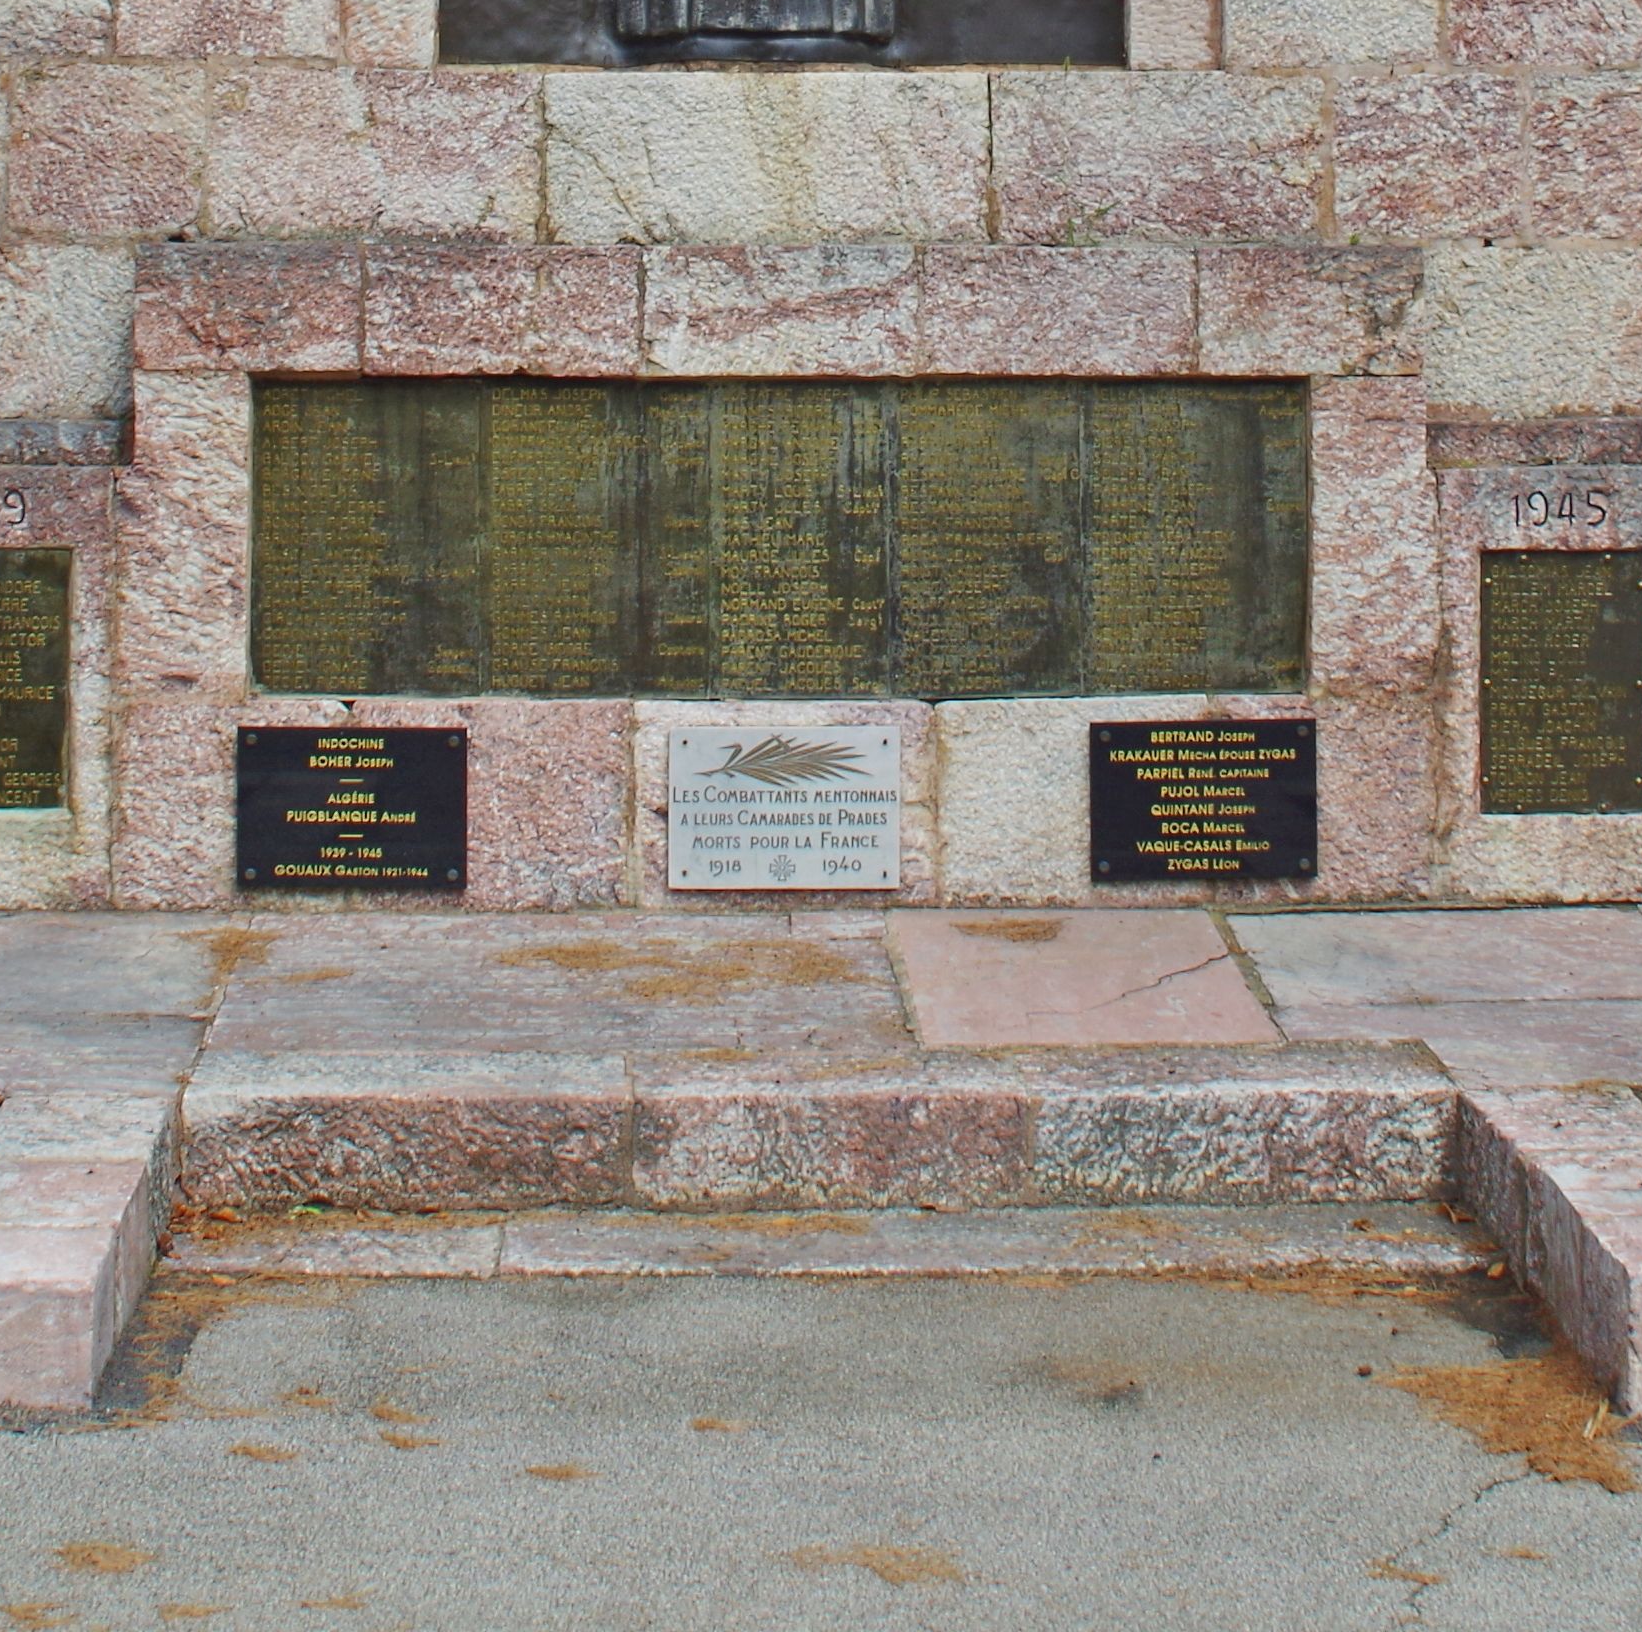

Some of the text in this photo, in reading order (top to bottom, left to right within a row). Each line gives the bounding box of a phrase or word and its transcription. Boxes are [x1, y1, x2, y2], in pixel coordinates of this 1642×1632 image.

[492, 389, 607, 401] DELMAS JOSEPH
[1511, 491, 1607, 527] 1945
[721, 550, 779, 563] MAURICE
[755, 566, 820, 578] FRANCOIS
[773, 583, 829, 594] JOSEPH
[1558, 582, 1612, 596] MARCEL
[721, 598, 845, 613] NORMAND EUGENE
[1545, 634, 1589, 647] ROGER
[553, 675, 591, 688] JEAN
[1491, 703, 1597, 716] PRATX GASTON
[1151, 731, 1255, 742] BERTRAND JOSEPH
[318, 739, 384, 749] INDOCHINE
[1110, 750, 1174, 761] KRAKAUER
[1259, 749, 1296, 759] ZYGAS
[309, 756, 351, 767] BOHER
[1137, 768, 1184, 779] PARPIEL
[1551, 771, 1587, 785] JEAN
[4, 773, 62, 787] GEORGES
[327, 791, 375, 803] ALGÉRIE
[814, 789, 897, 803] MENTONNAIS
[1161, 787, 1199, 797] PUJOL
[1151, 804, 1214, 816] QUINTANE
[286, 811, 377, 822] PUIGBLANQUE
[681, 812, 688, 825] A
[694, 811, 733, 825] LEURS
[819, 812, 833, 825] DE
[1162, 823, 1199, 834] ROCA
[693, 835, 740, 849] MORTS
[750, 835, 789, 848] POUR
[795, 835, 812, 848] LA
[1137, 840, 1231, 852] VAQUE-CASALS
[321, 848, 346, 858] 1939
[358, 848, 382, 858] 1945
[274, 864, 331, 875] GOUAUX
[709, 856, 862, 877] 1918 1940
[1168, 859, 1208, 870] ZYGAS
